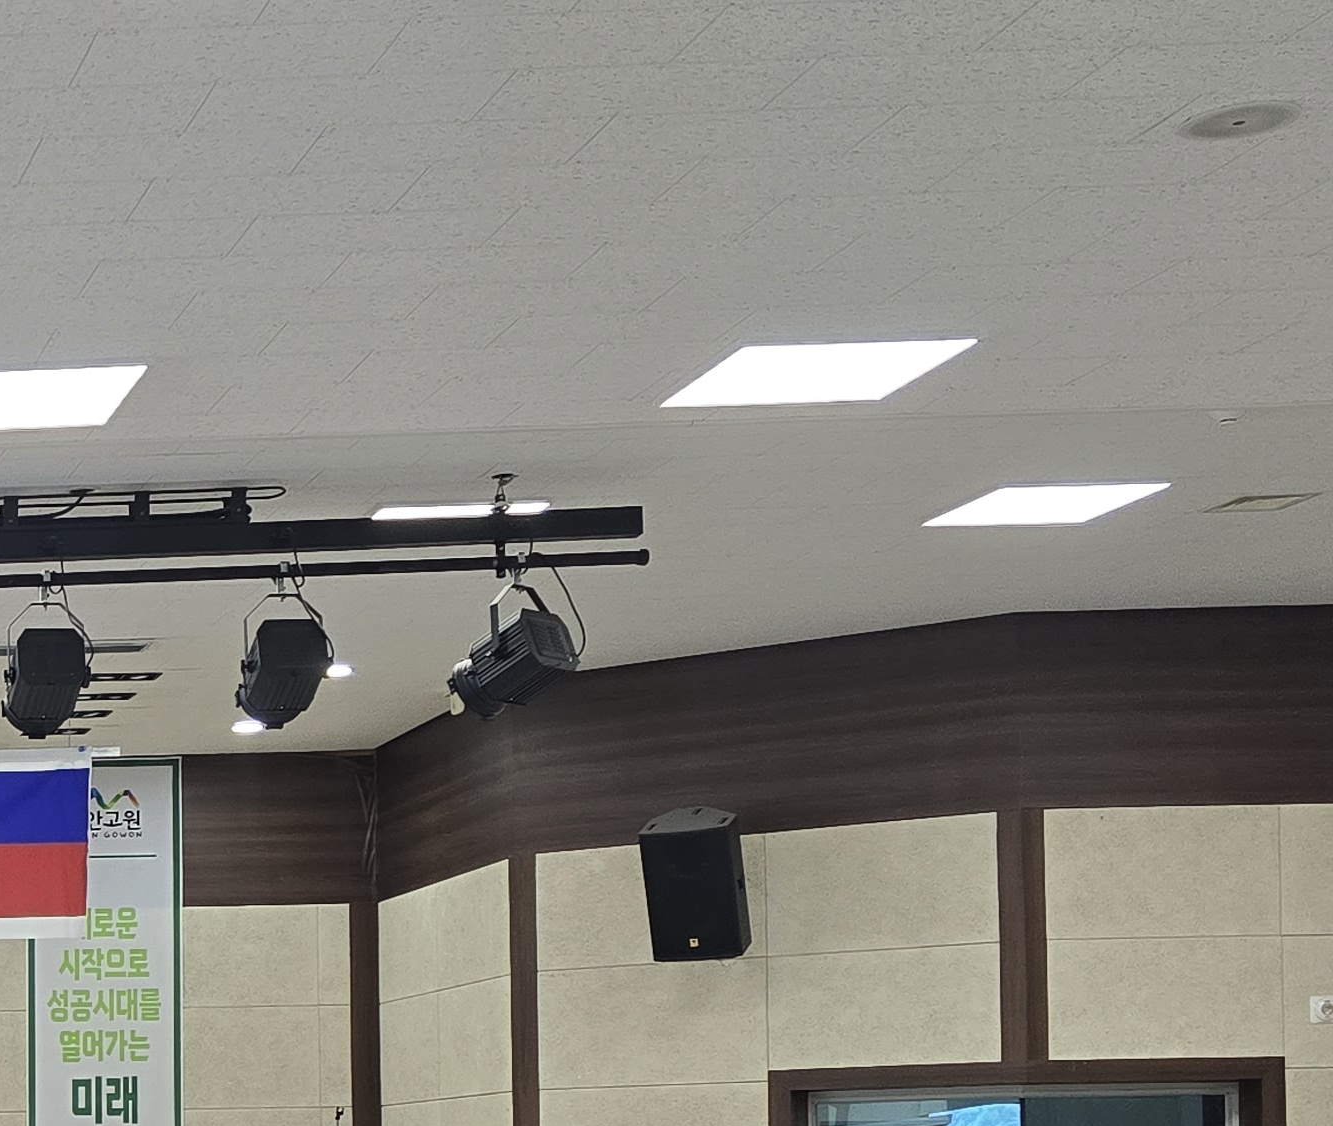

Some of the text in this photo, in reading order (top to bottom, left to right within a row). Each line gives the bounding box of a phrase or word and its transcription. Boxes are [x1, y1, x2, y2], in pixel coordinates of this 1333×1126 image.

[90, 810, 141, 830] 안고원
[84, 907, 138, 940] 로운
[59, 948, 150, 980] 시작으로
[47, 988, 161, 1022] 성공시대를
[60, 1030, 150, 1062] 열어가는
[71, 1076, 138, 1124] 미래
